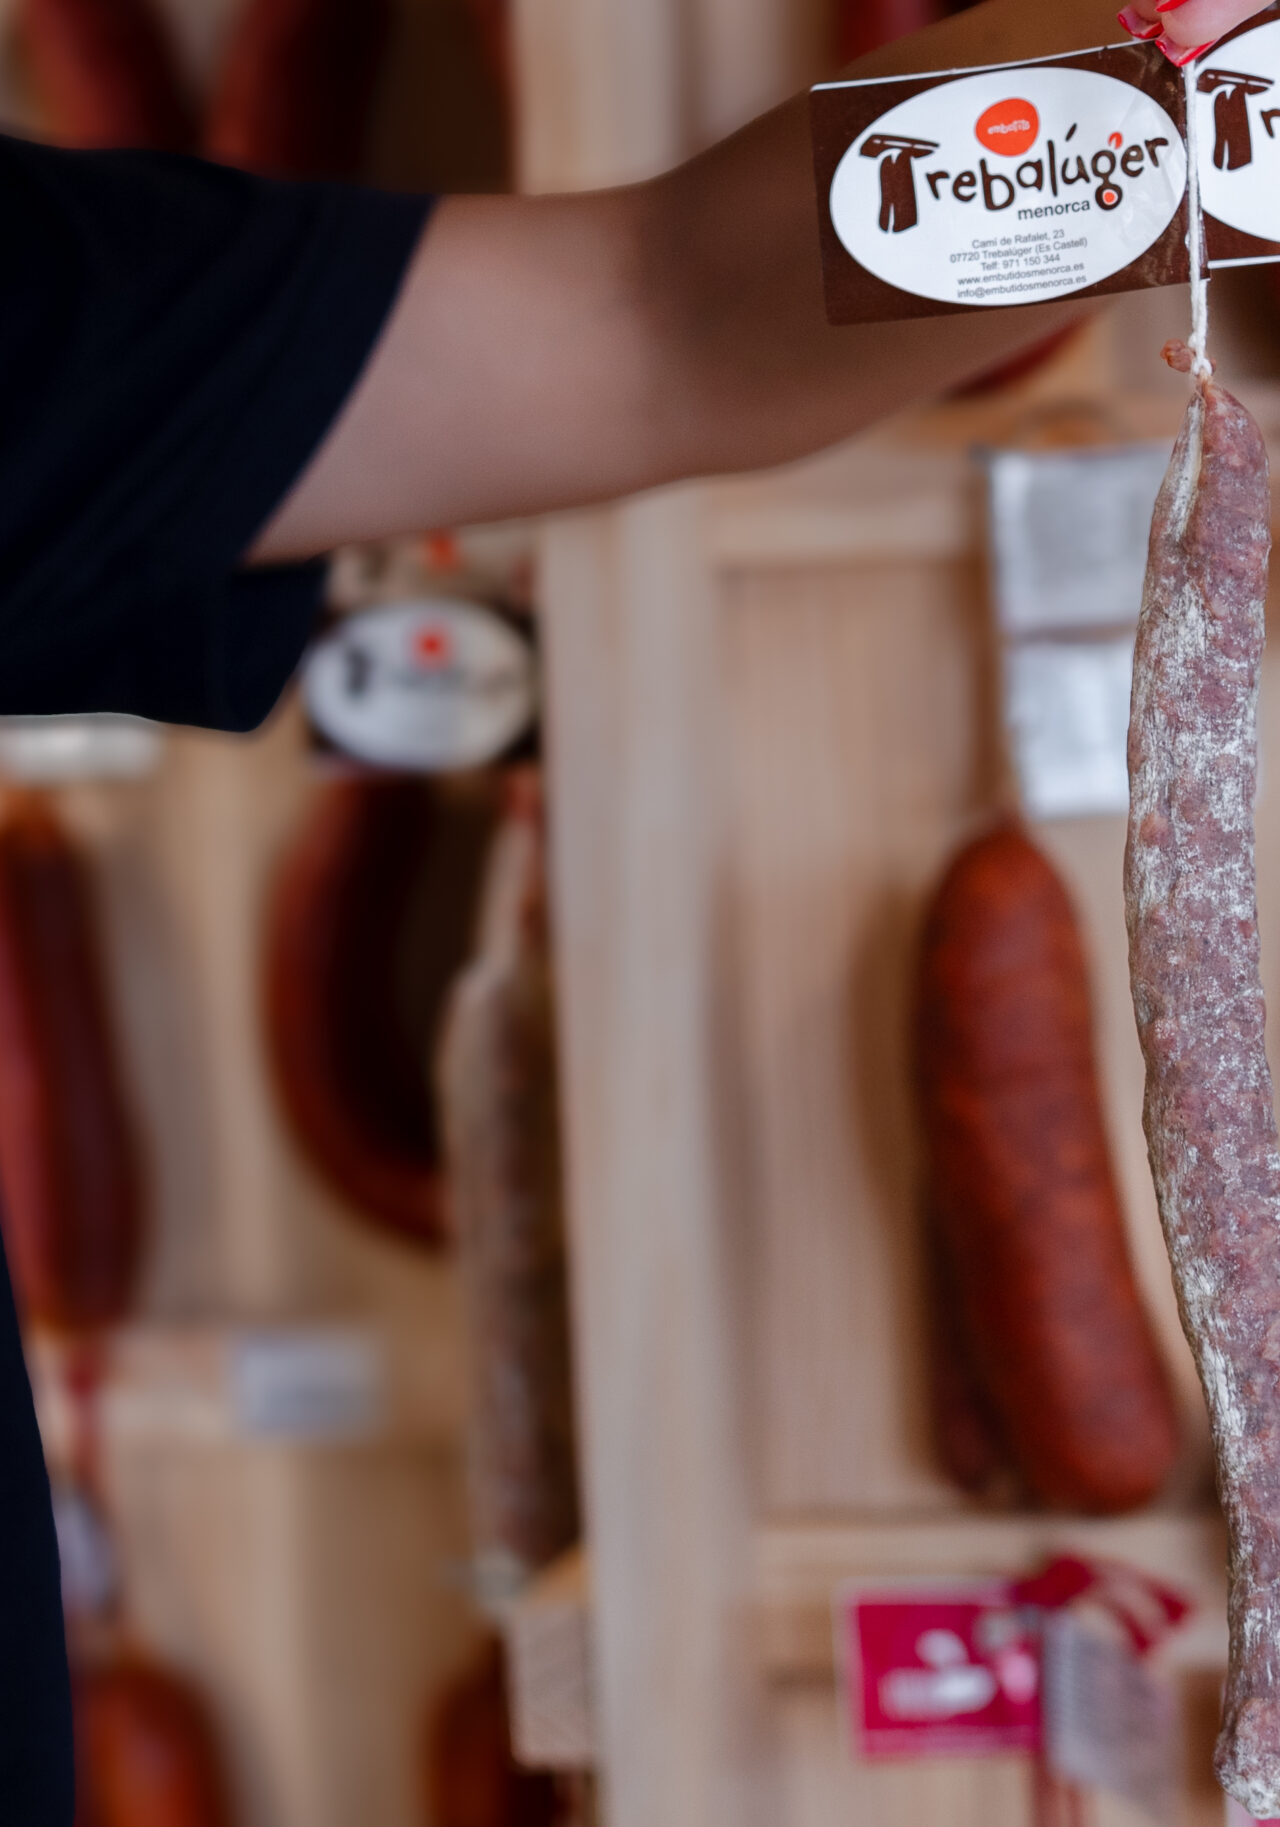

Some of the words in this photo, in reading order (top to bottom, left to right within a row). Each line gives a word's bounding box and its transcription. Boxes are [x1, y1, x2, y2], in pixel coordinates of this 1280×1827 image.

[859, 122, 1169, 235] Trebalúger
[1017, 200, 1091, 221] menorca
[999, 236, 1013, 246] de
[1052, 228, 1065, 240] 23
[949, 251, 980, 264] 07720
[981, 245, 1032, 260] Trebalúger
[1034, 241, 1052, 255] (Es
[1053, 237, 1088, 251] Castell)
[1002, 257, 1020, 270] 971
[1024, 255, 1041, 267] 150
[1043, 252, 1061, 265] 344
[956, 262, 1085, 286] www.embutidosmenorca.es
[956, 275, 1087, 299] info@embutidosmenorca.es
